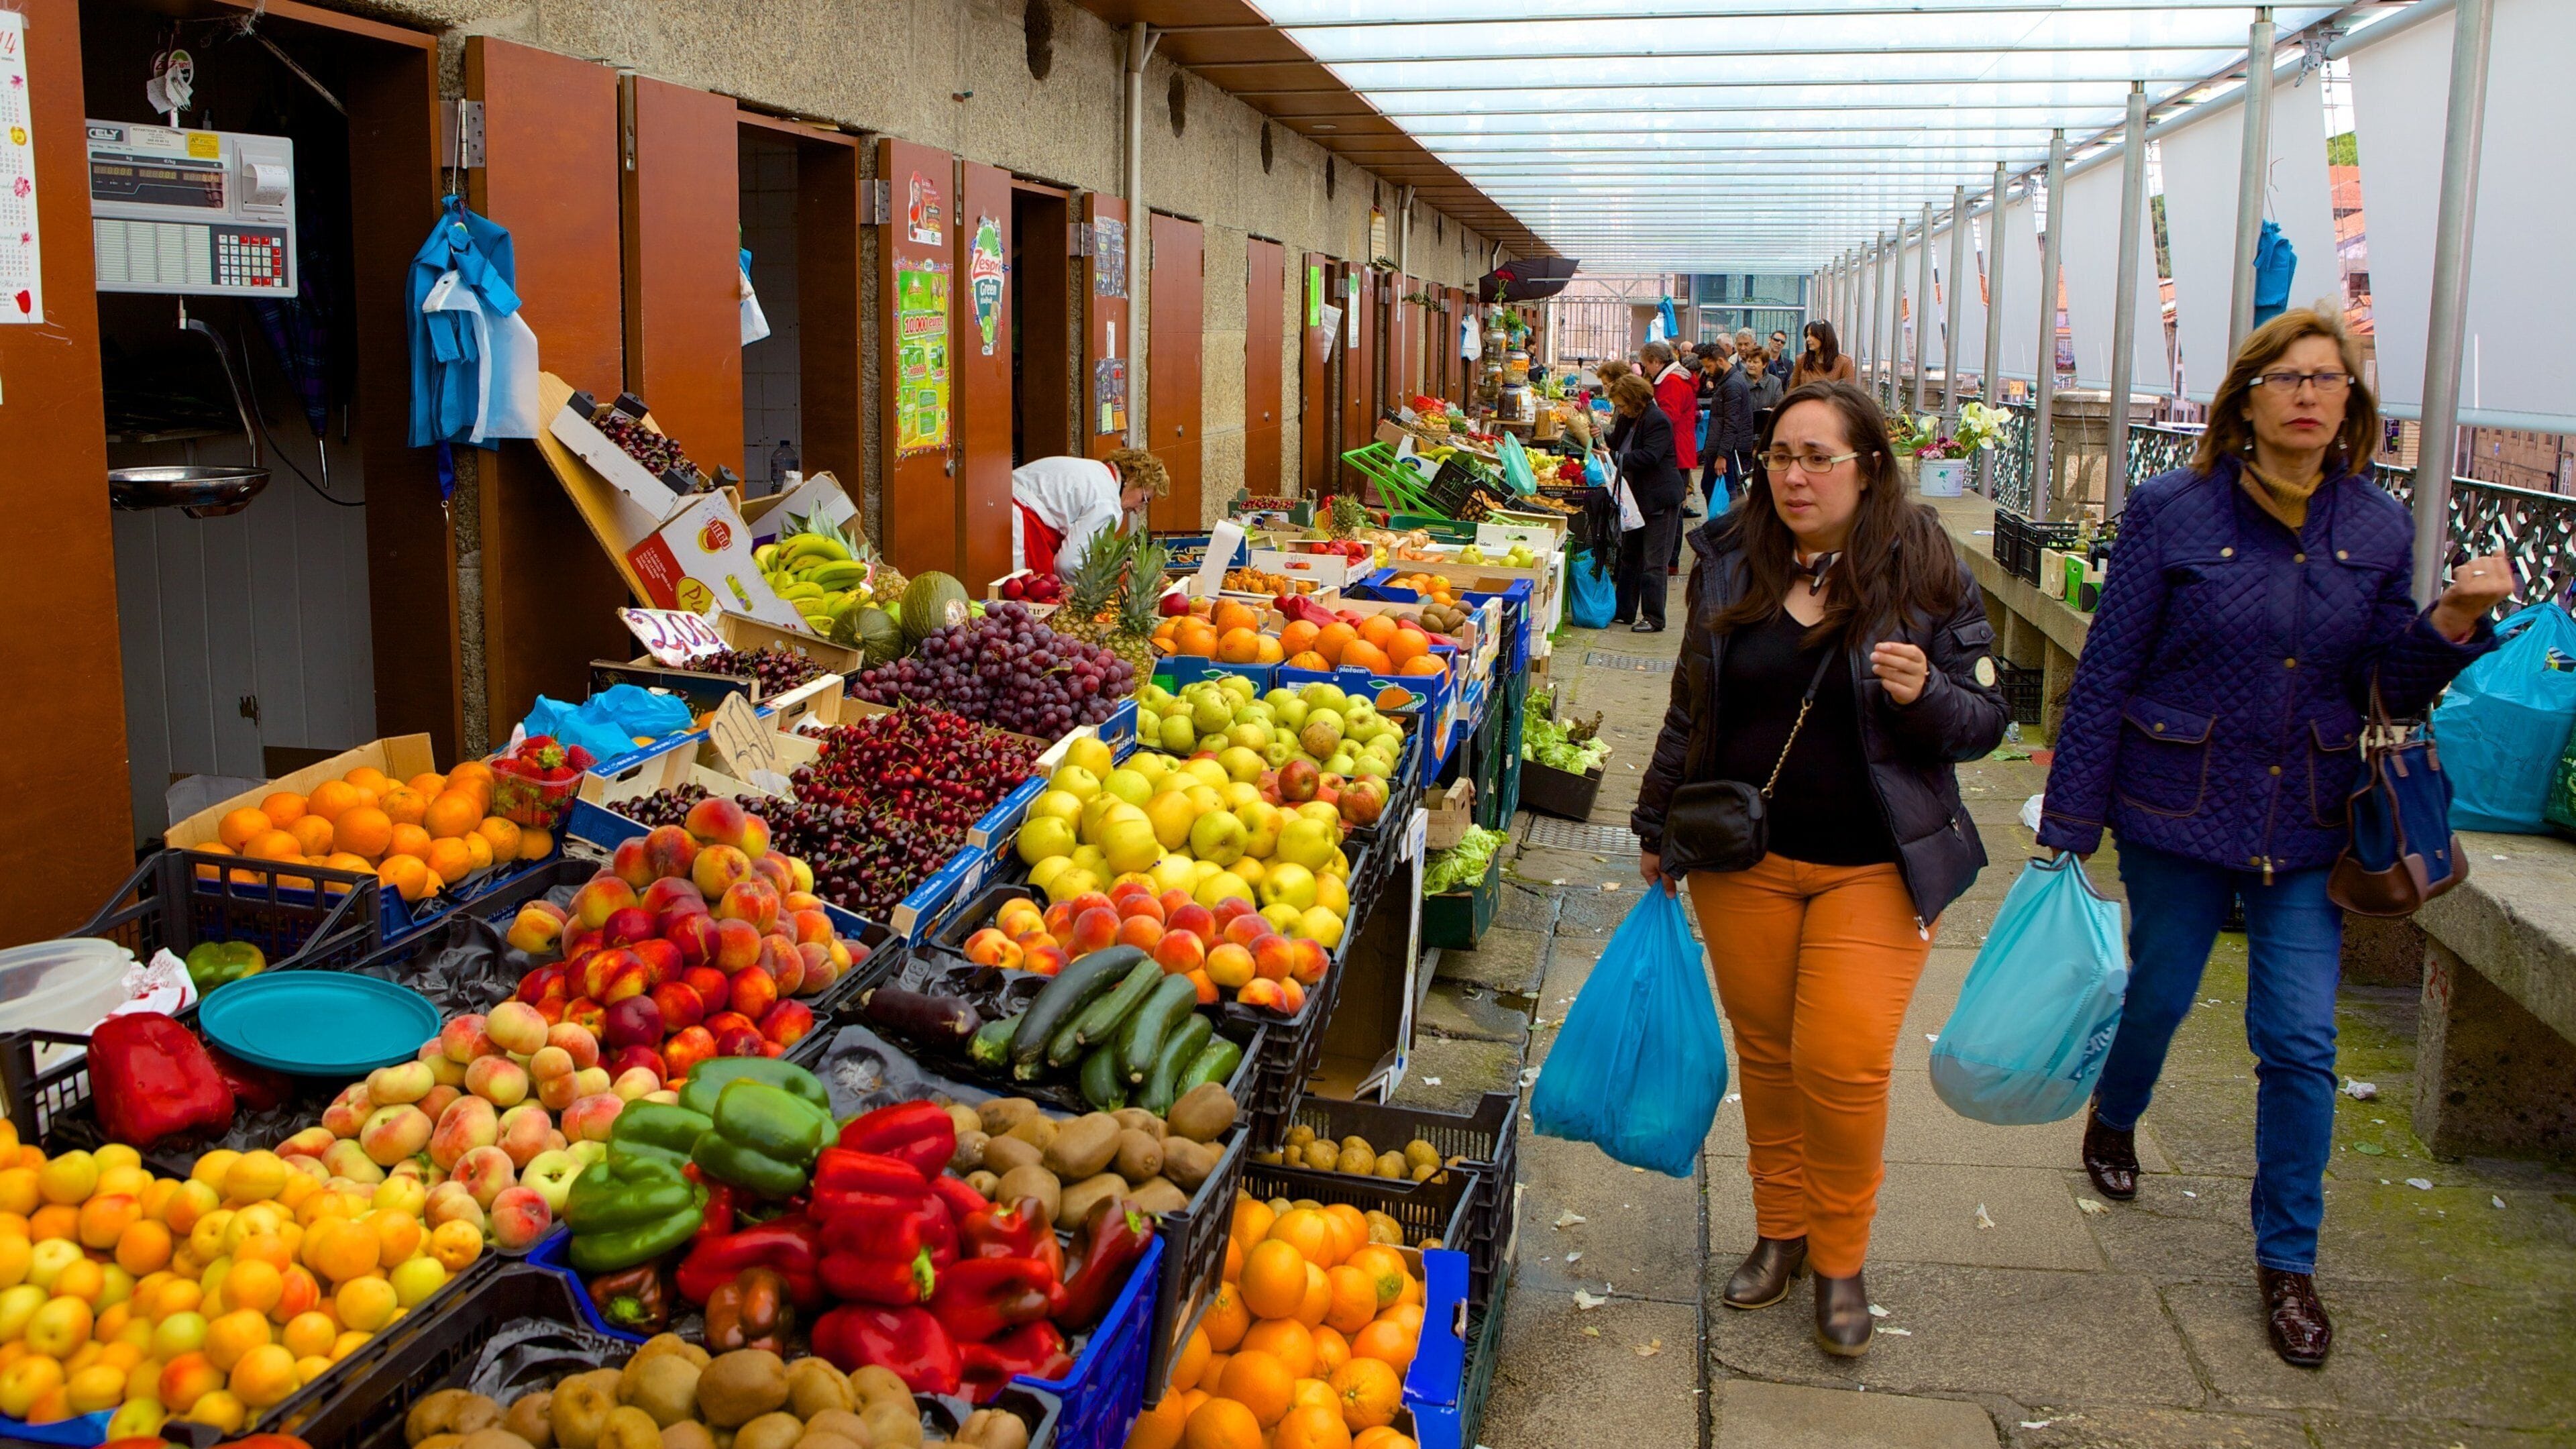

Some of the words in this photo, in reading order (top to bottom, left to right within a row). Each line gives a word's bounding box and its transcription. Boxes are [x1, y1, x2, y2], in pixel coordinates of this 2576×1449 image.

[89, 128, 119, 140] CELY
[973, 250, 1002, 280] Zespri
[980, 282, 997, 297] Green
[709, 518, 731, 550] RIEGO
